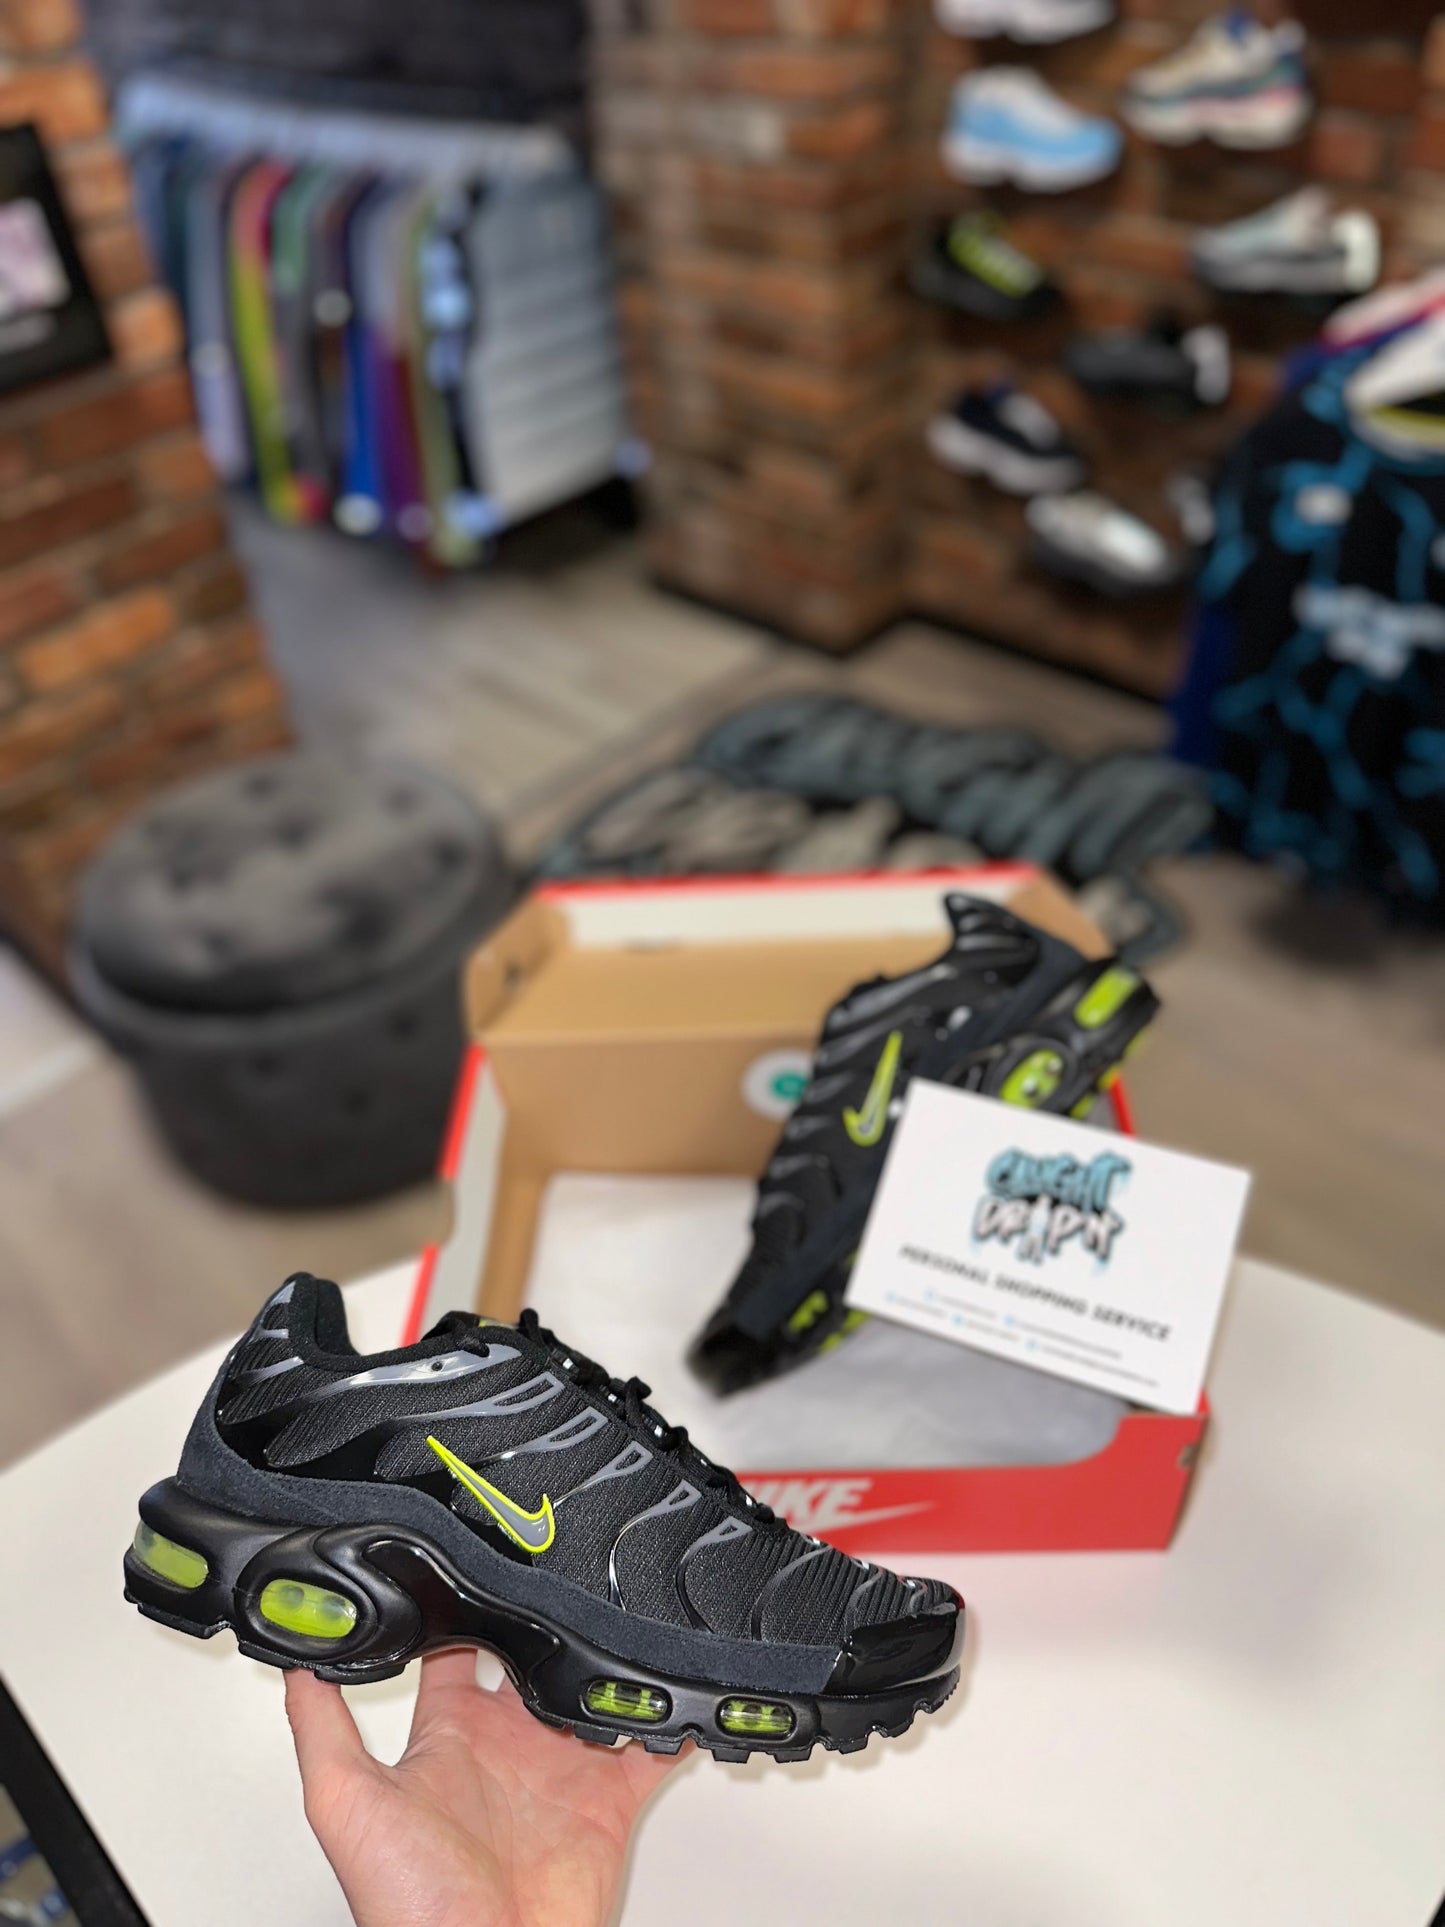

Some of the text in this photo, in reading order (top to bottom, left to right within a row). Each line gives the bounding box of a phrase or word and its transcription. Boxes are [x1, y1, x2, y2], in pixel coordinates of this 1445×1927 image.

[986, 1148, 1132, 1213] CAUGHT
[899, 1245, 988, 1285] PERSONAL
[995, 1273, 1087, 1315] SHOPPING
[1091, 1303, 1172, 1342] SERVICE
[740, 1478, 873, 1523] IKE
